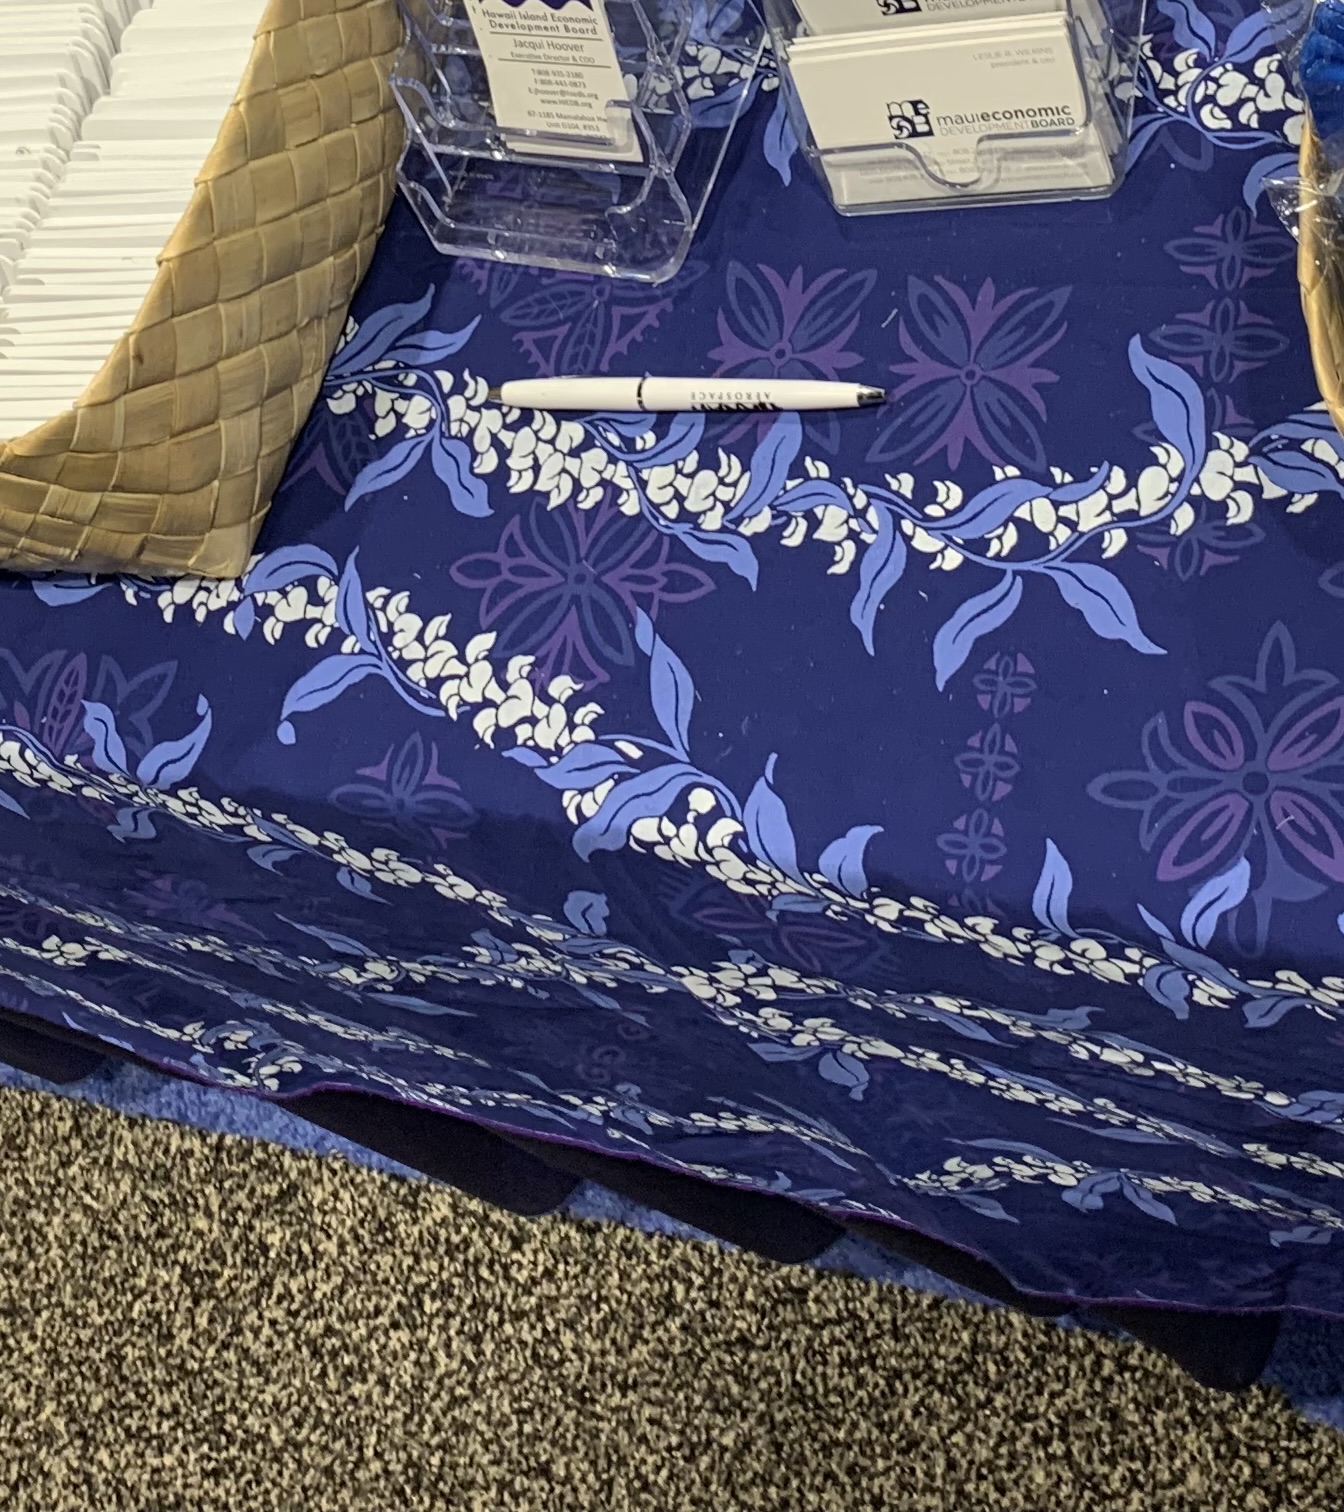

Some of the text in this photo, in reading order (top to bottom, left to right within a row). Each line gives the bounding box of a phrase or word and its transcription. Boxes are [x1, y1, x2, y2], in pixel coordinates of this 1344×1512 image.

[481, 8, 598, 25] Hawaii Island Economic
[488, 18, 598, 35] Development Board
[512, 37, 584, 52] Jacqui Hoover
[935, 104, 1071, 126] mauieconomic
[690, 391, 772, 401] AEROSPACE
